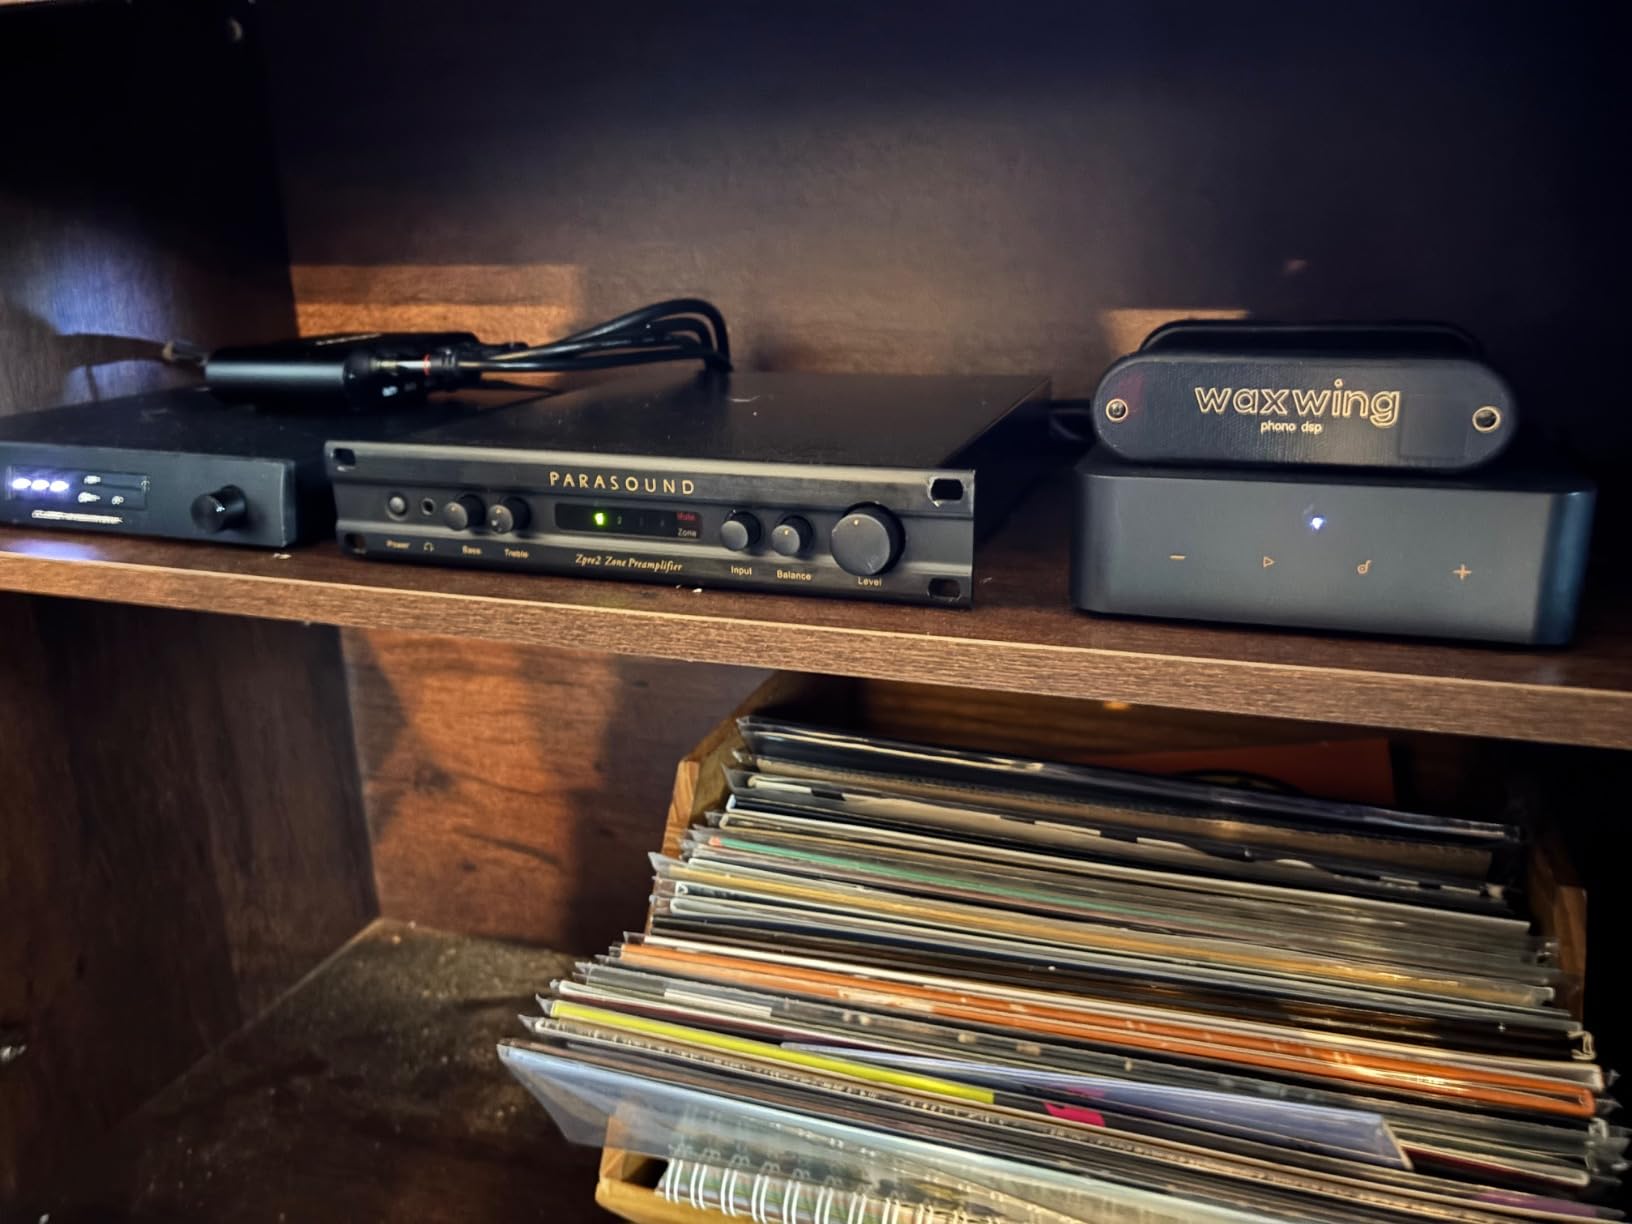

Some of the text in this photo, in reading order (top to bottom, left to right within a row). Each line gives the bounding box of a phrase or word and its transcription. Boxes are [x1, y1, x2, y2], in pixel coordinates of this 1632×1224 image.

[1194, 378, 1400, 428] waxwing
[1260, 421, 1323, 435] phono dsp
[549, 471, 695, 495] PARASOUND
[677, 527, 697, 538] Zone
[504, 548, 529, 559] Treble
[575, 553, 683, 574] Zpre2 Zone Preamplifier
[731, 566, 753, 577] Input
[776, 569, 812, 581] Balance
[857, 577, 882, 588] Level
